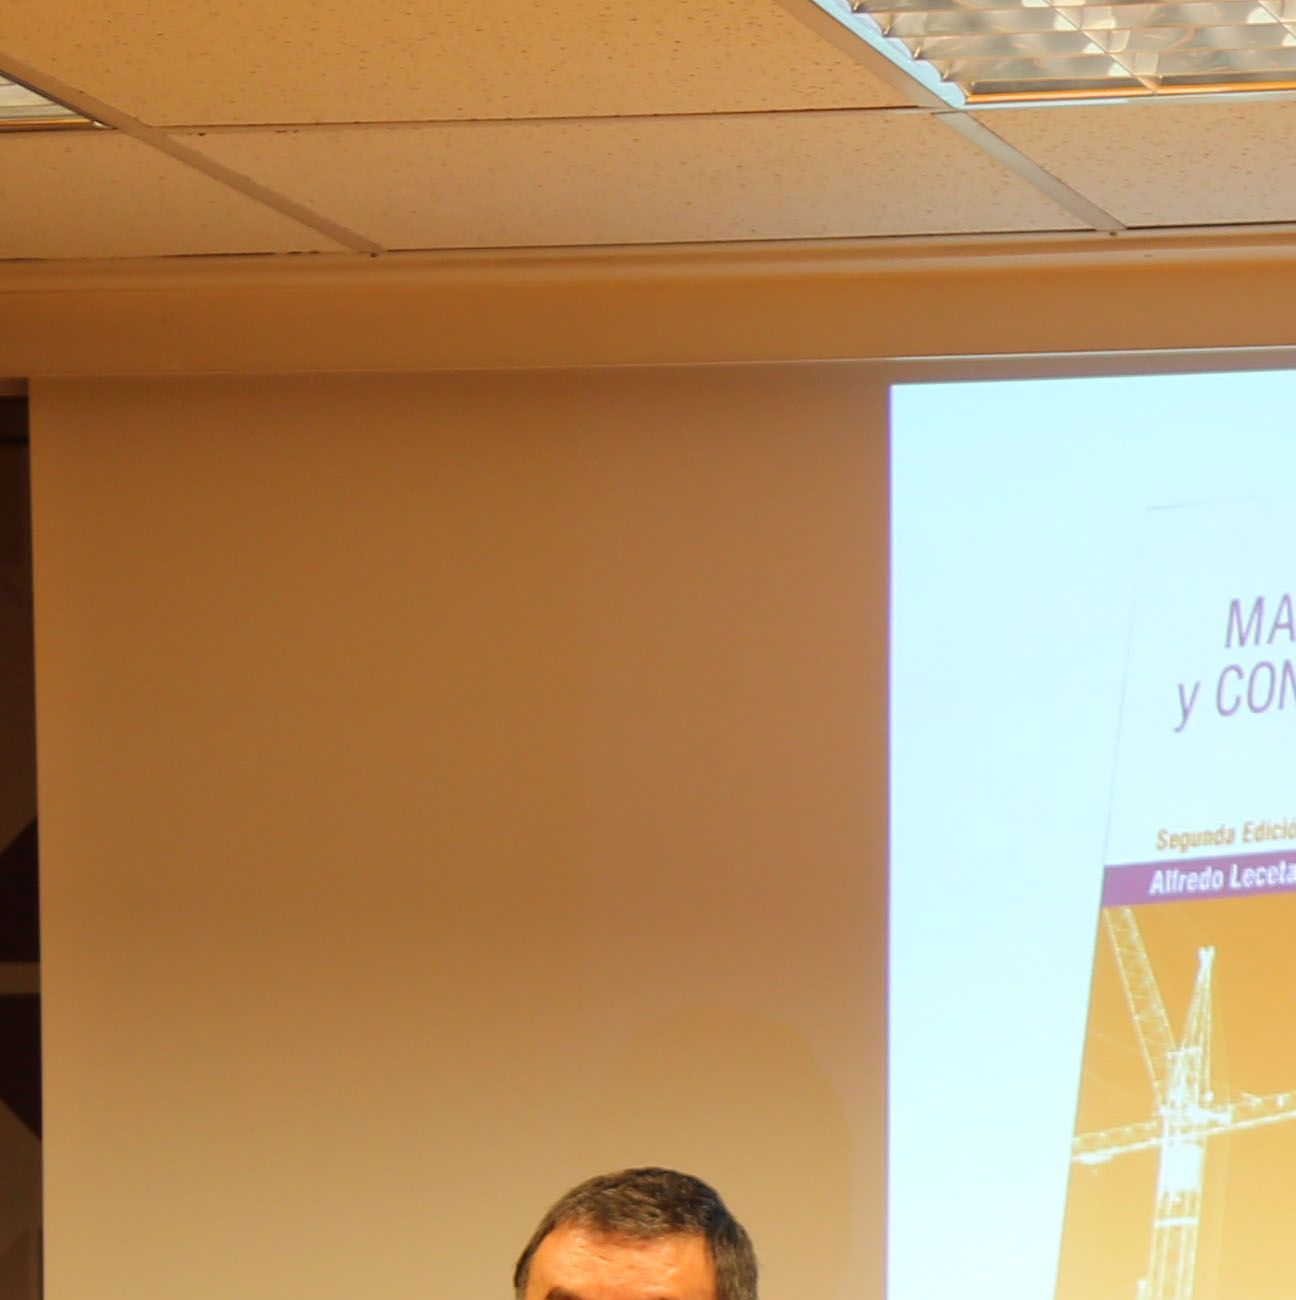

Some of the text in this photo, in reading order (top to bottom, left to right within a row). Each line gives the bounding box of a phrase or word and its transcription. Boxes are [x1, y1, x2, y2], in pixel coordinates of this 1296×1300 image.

[1173, 680, 1201, 733] y
[1156, 825, 1236, 854] Segunda
[1149, 866, 1225, 895] Alfredo
